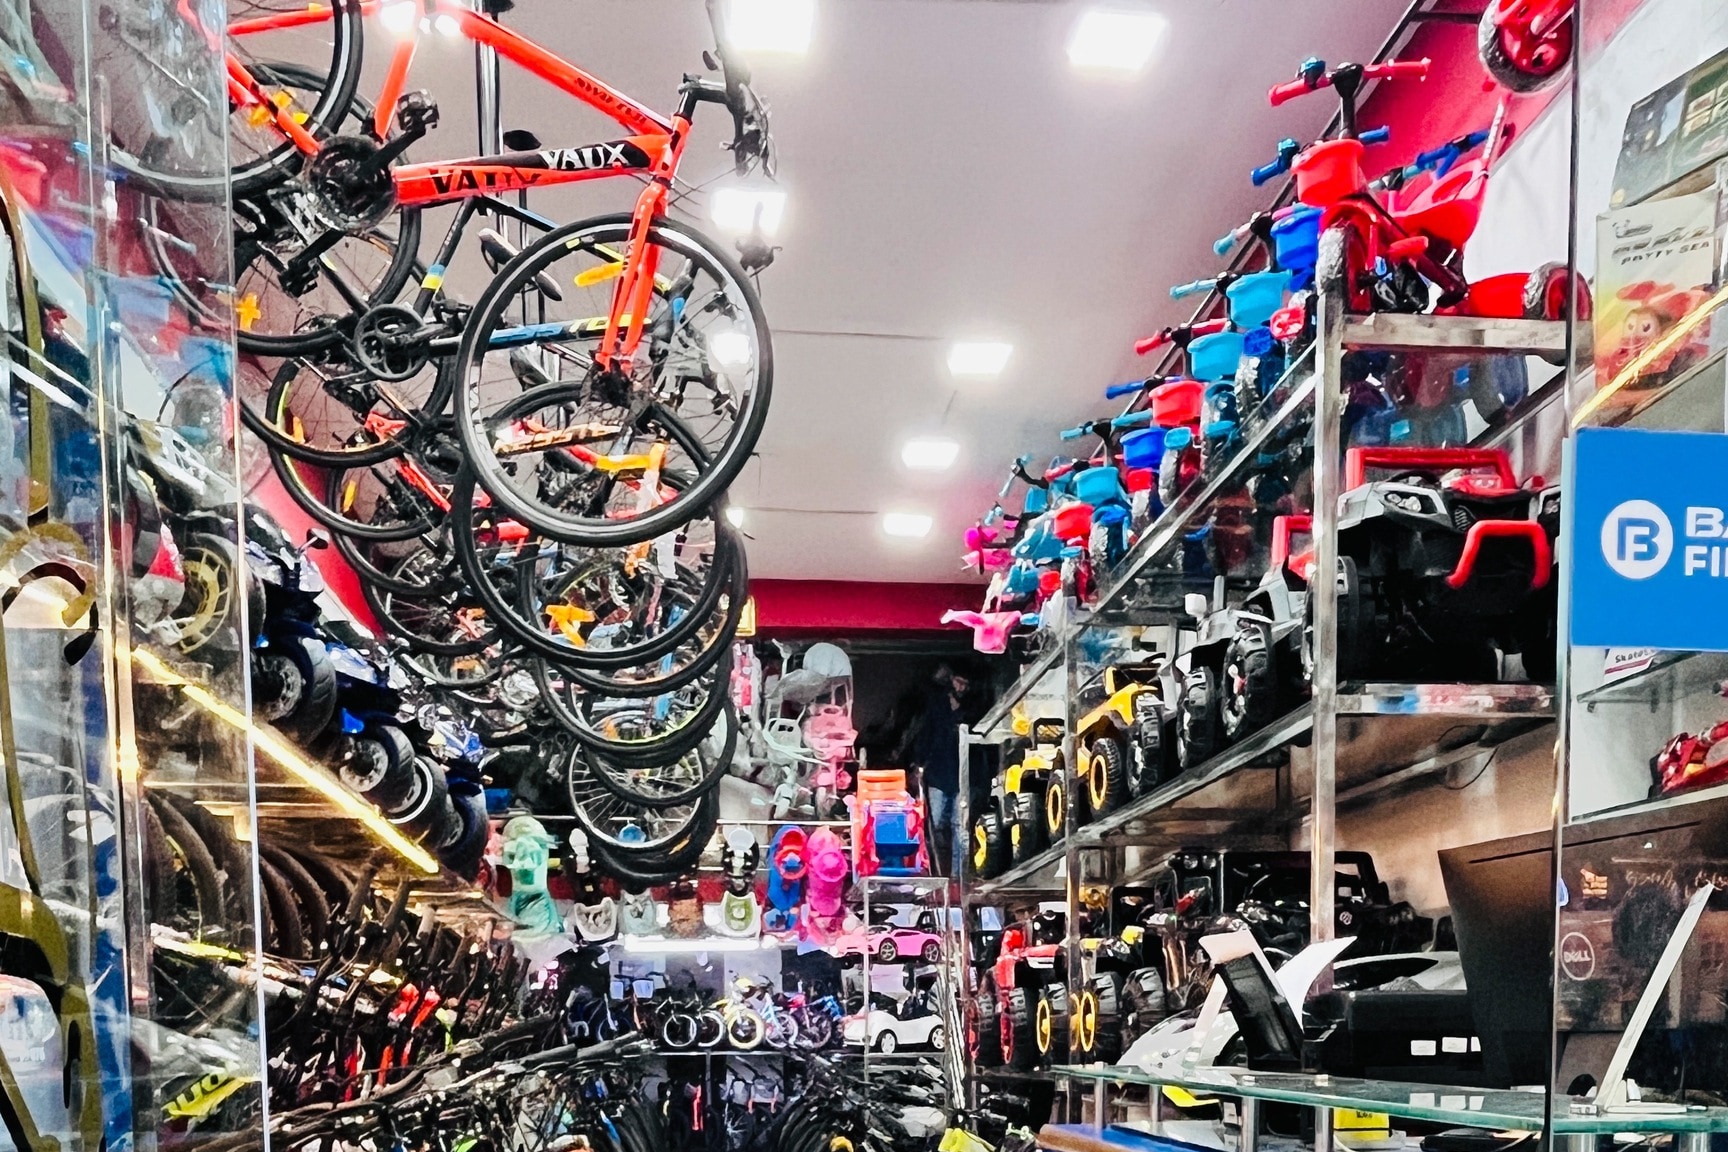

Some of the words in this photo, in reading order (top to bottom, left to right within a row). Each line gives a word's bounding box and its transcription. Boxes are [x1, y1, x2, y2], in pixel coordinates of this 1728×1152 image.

[540, 142, 631, 170] VAUX
[1684, 545, 1728, 577] FI
[1563, 949, 1592, 964] DELL
